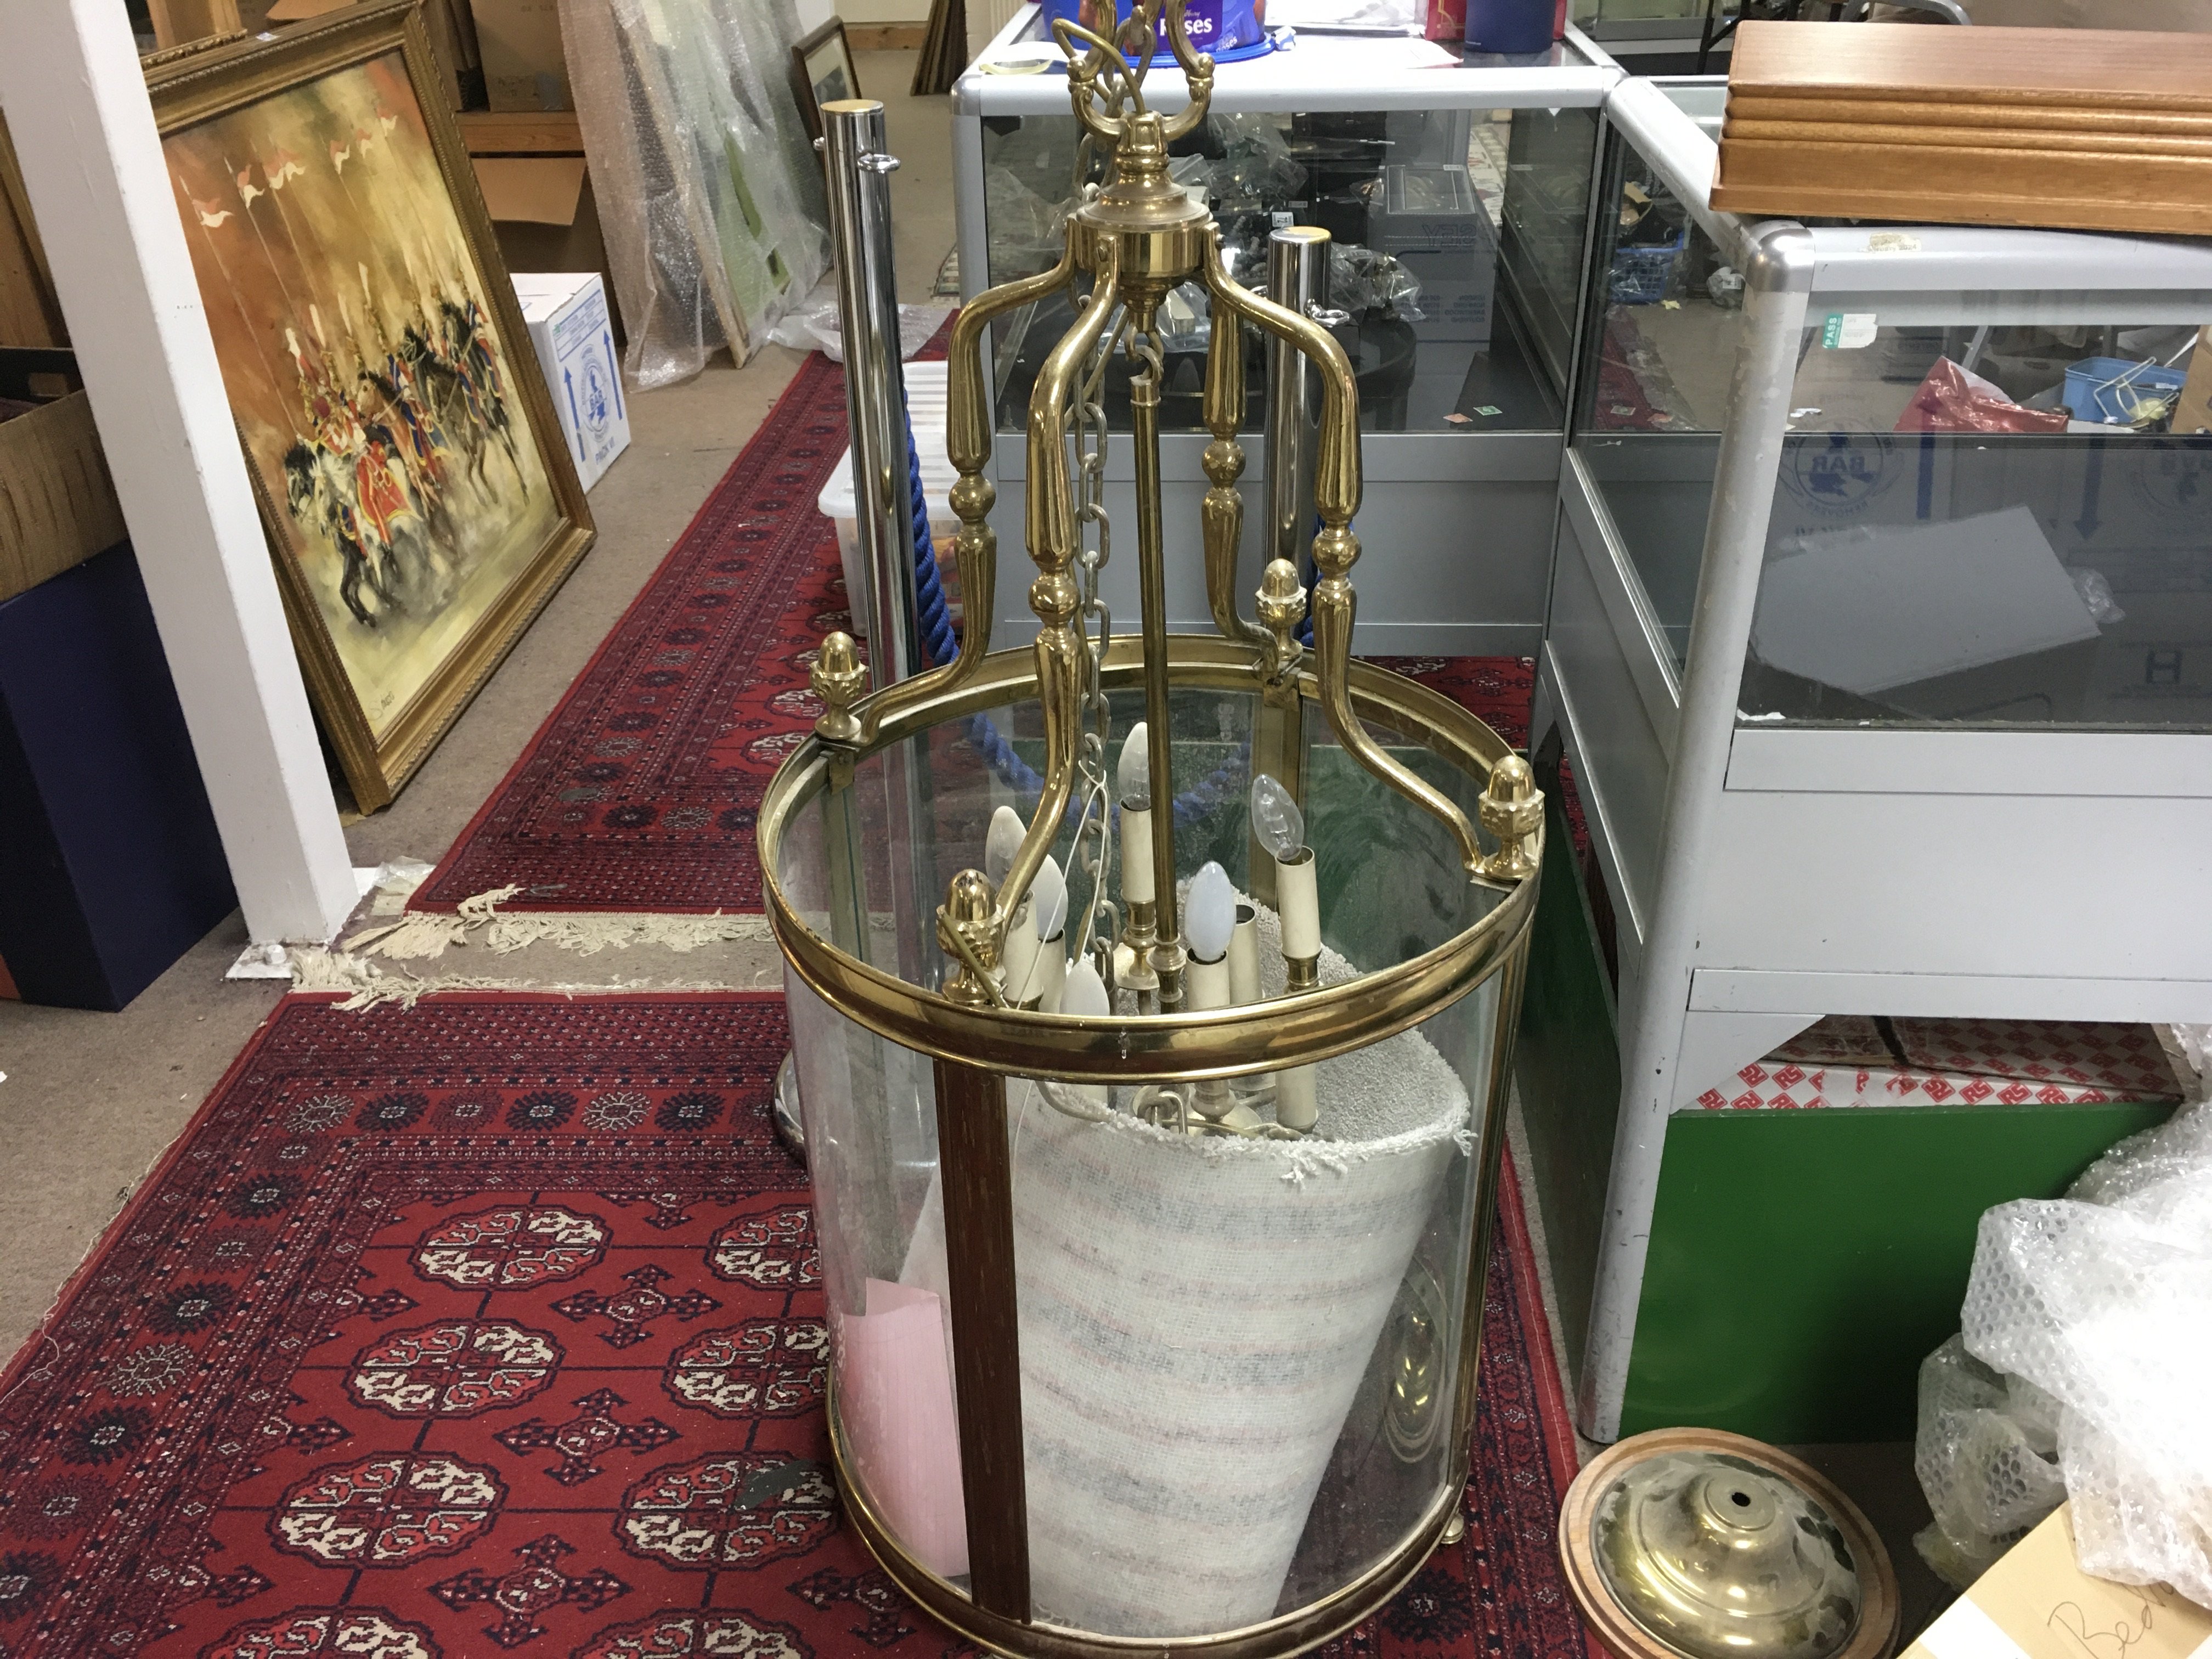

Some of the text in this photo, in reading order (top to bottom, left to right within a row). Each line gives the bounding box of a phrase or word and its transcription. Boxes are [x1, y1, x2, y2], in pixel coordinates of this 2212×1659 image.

[1825, 317, 1838, 346] PASS
[589, 389, 603, 410] BAR
[1774, 1065, 1805, 1089] RS
[1922, 1077, 1954, 1101] RS
[1961, 1080, 1993, 1104] RS
[1999, 1084, 2031, 1104] RS
